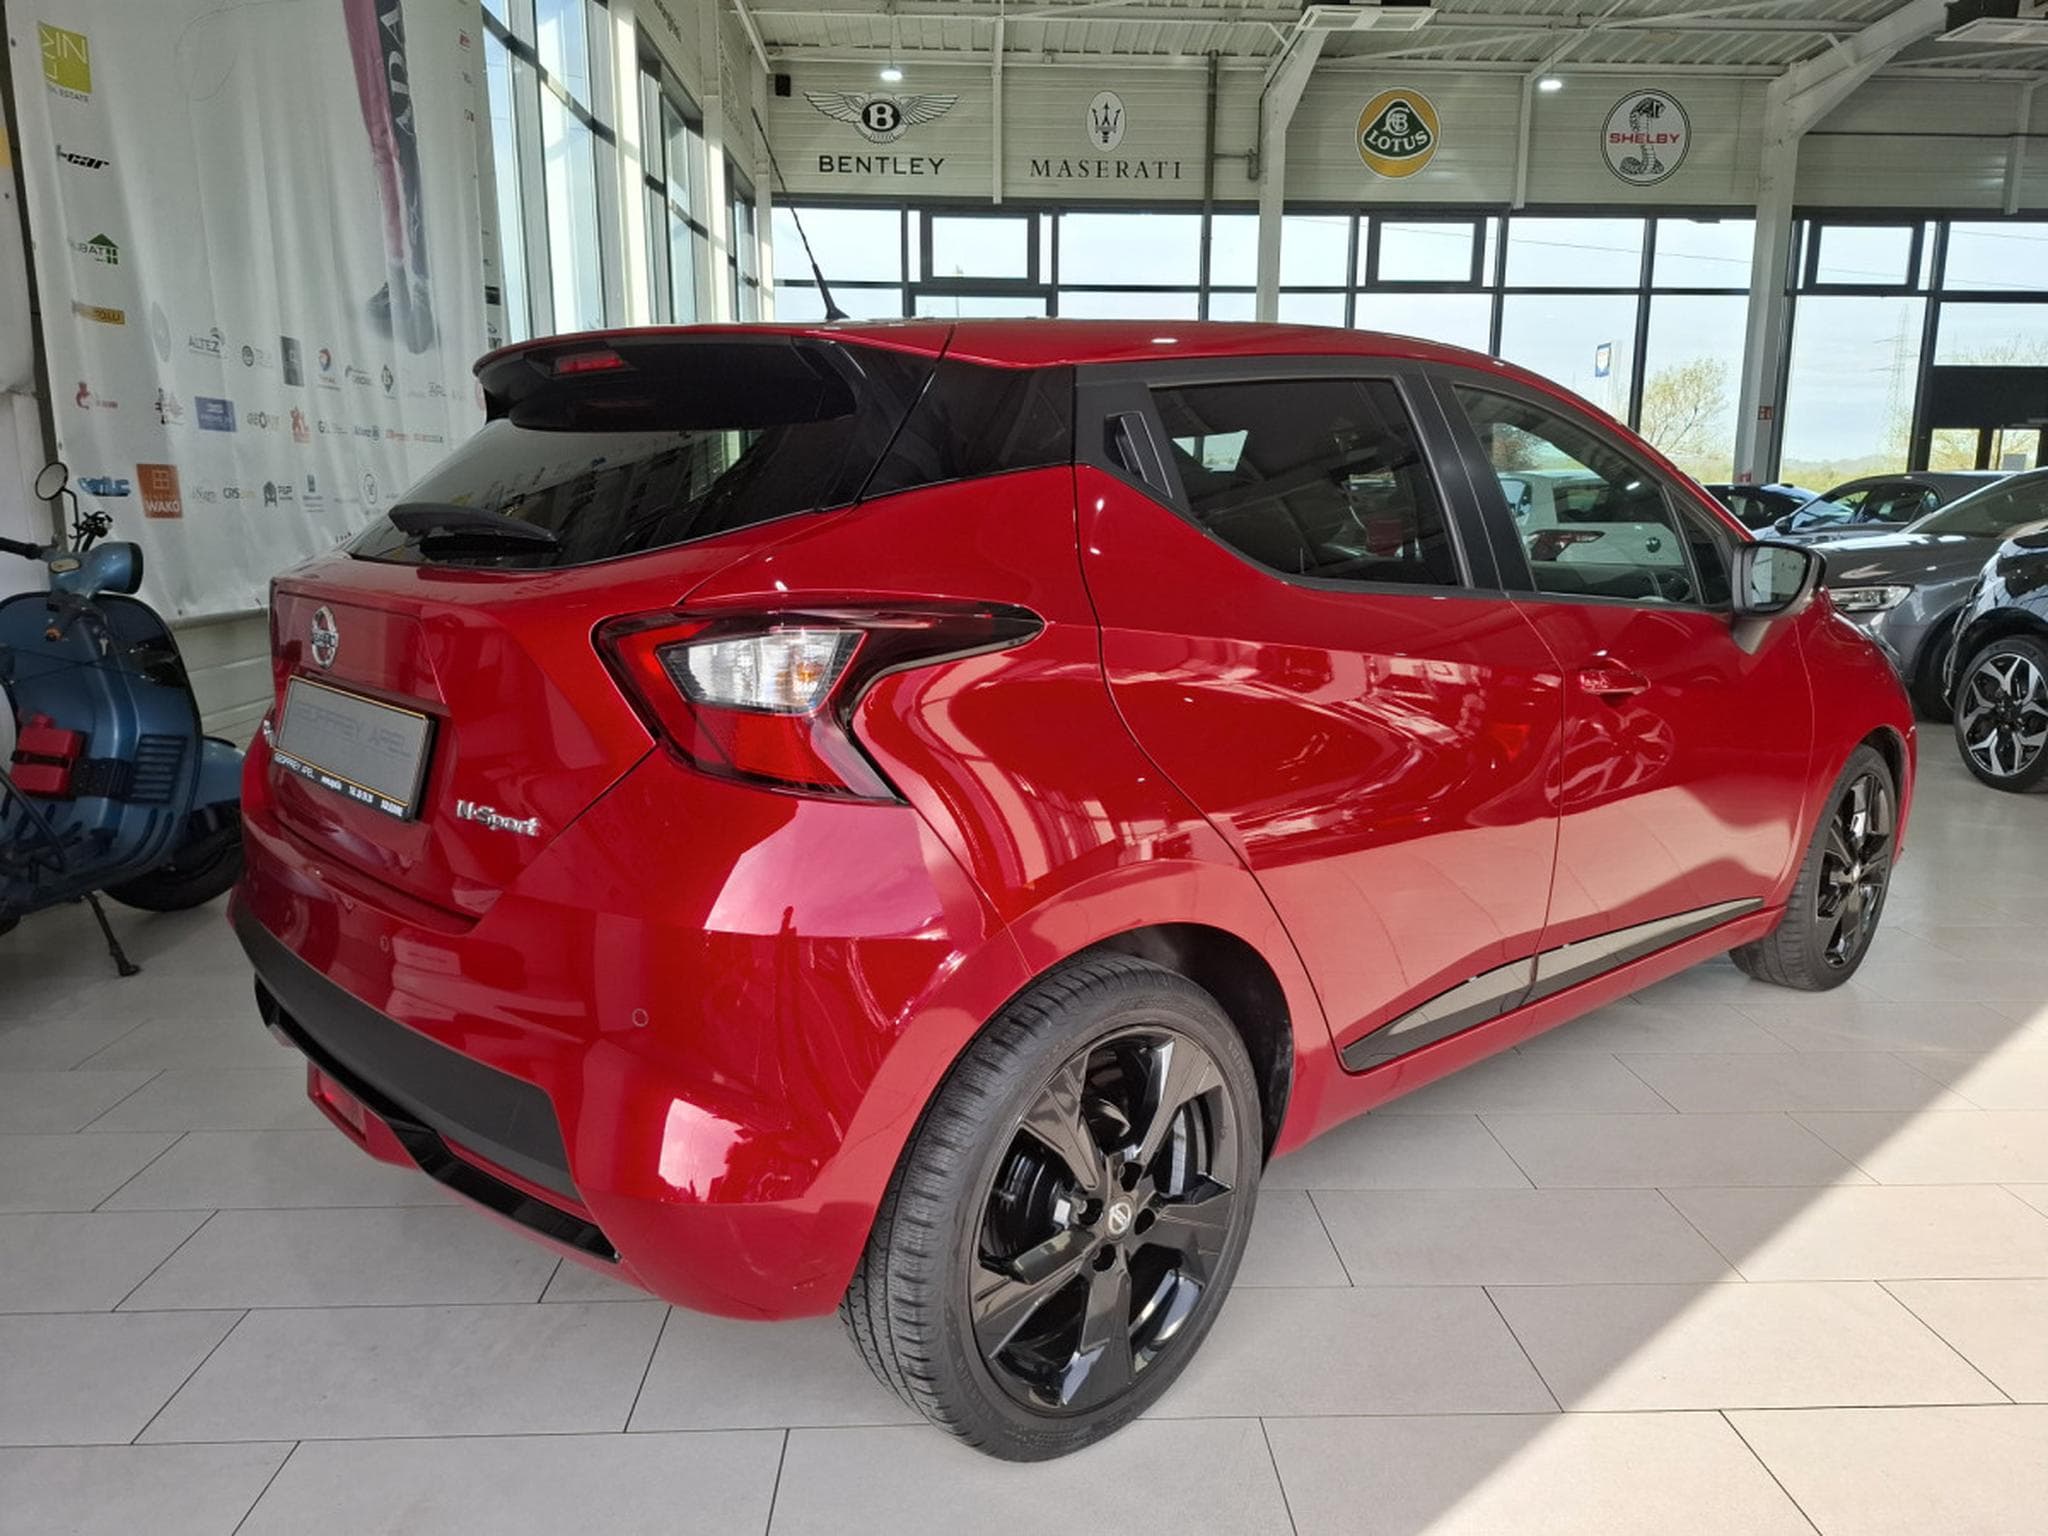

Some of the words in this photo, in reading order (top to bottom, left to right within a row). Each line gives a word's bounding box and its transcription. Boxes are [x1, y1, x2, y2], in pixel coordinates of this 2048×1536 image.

[868, 103, 895, 131] B
[1367, 129, 1428, 153] LOTUS
[1609, 132, 1680, 144] SHELBY
[818, 155, 945, 175] BENTLEY
[1030, 159, 1182, 179] MASERATI
[145, 500, 181, 513] WAKO
